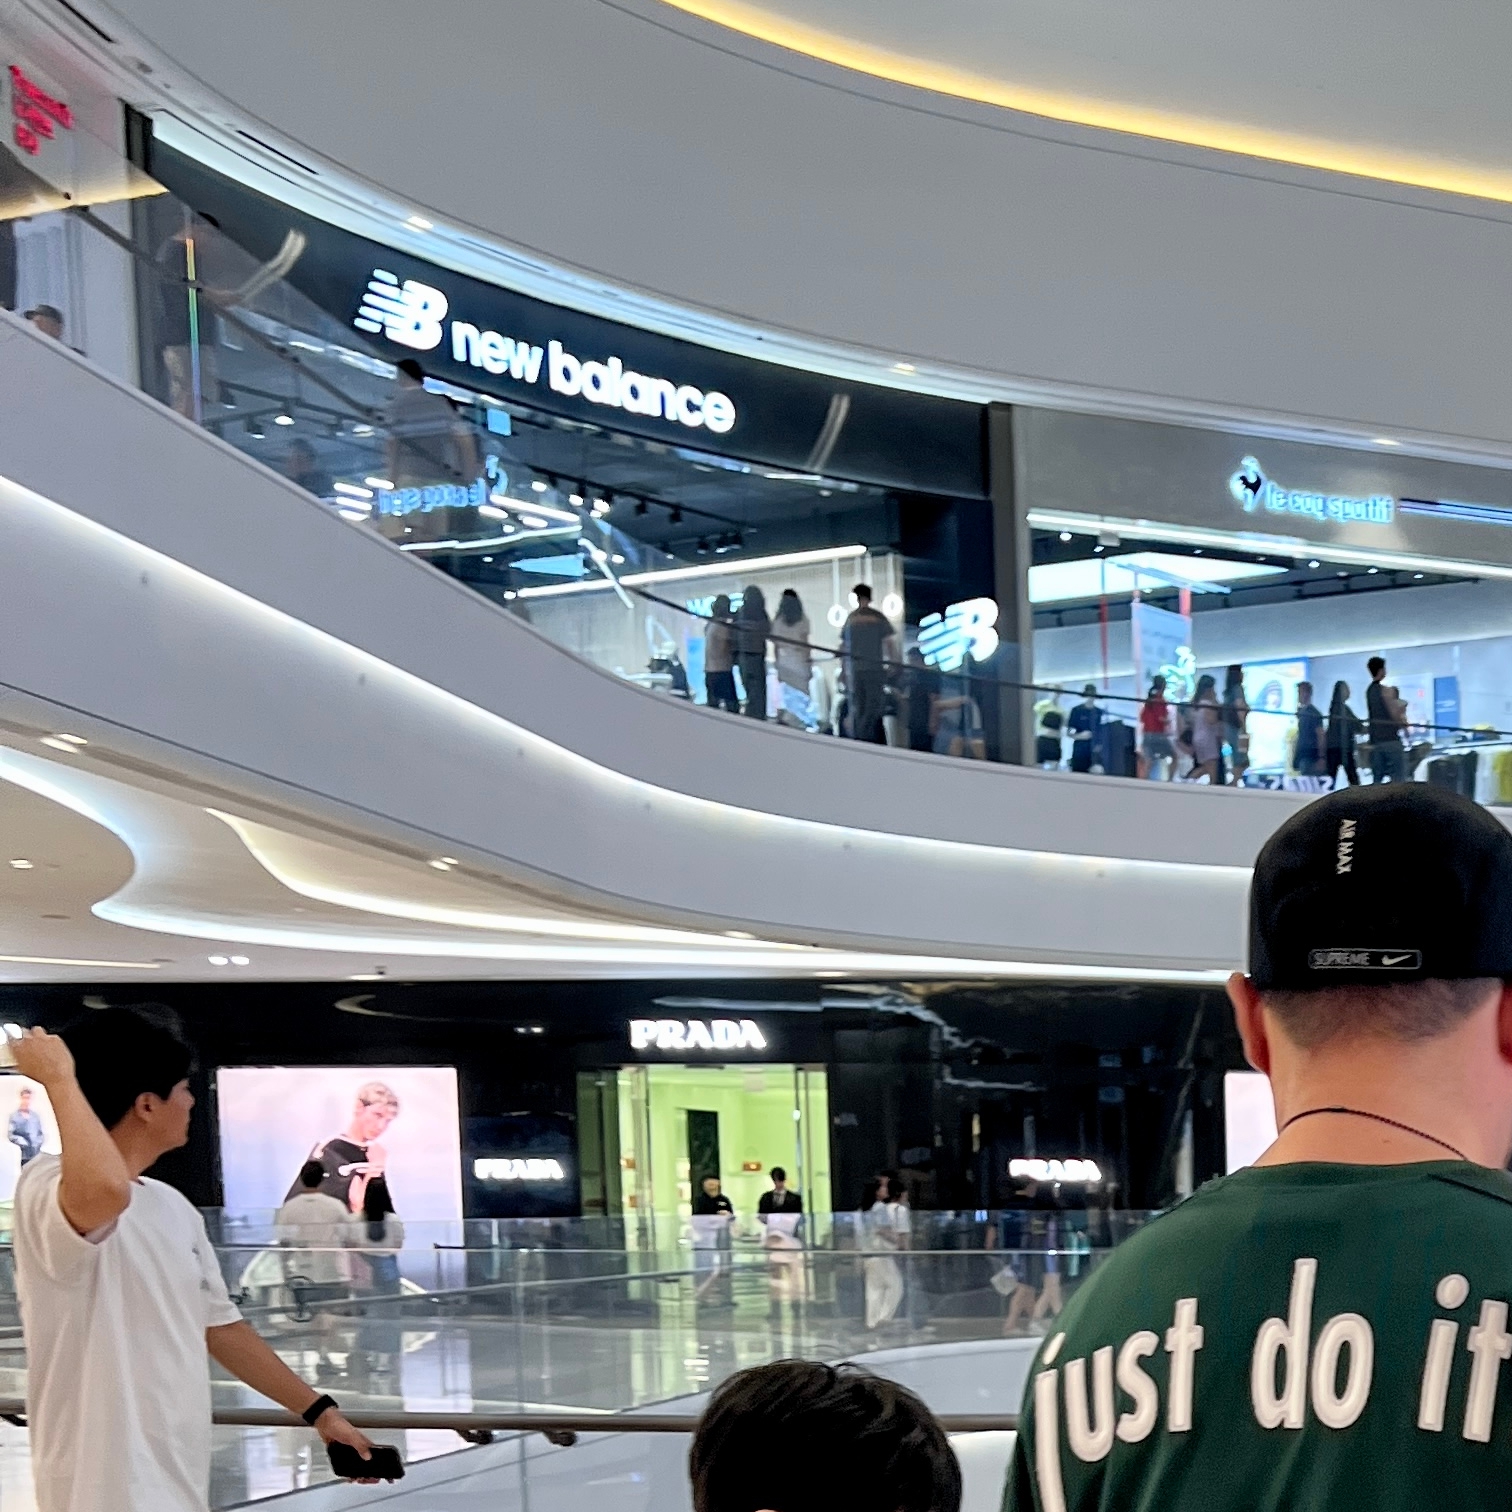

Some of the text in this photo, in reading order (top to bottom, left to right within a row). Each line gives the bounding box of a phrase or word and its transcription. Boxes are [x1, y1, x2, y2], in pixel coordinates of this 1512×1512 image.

[451, 320, 544, 383] new
[548, 340, 736, 433] balance
[1336, 841, 1355, 875] MAX
[629, 1019, 768, 1050] PRADA
[473, 1158, 565, 1180] PRADA
[1008, 1158, 1102, 1181] PRADA
[1251, 1258, 1374, 1430] do
